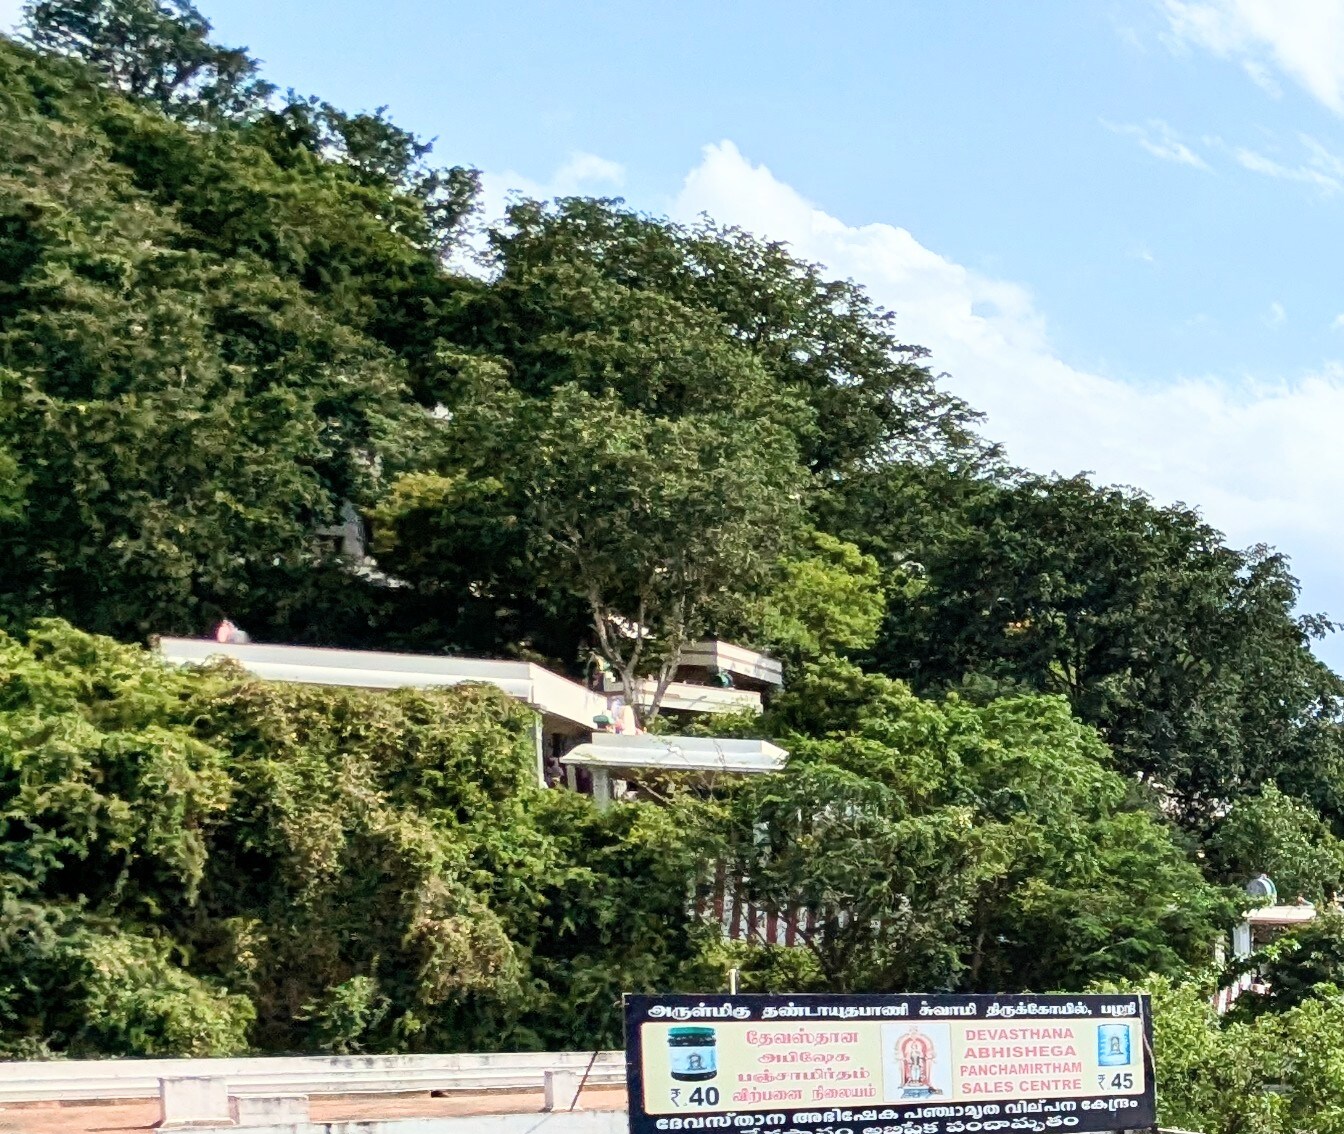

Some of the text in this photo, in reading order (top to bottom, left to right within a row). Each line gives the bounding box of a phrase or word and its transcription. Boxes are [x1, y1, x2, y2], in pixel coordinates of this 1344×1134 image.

[647, 1002, 751, 1020] அருள்மிகு
[761, 1001, 909, 1018] தண்டாயுதபாணி
[746, 1027, 860, 1047] தேவஸ்தான
[965, 1028, 1075, 1042] DEVASTHANA
[757, 1050, 851, 1064] அபிஷேக
[963, 1045, 1077, 1060] ABHISHEGA
[959, 1062, 1083, 1077] PANCHAMIRTHAM
[732, 1083, 877, 1105] விற்பனை நிலையம்
[962, 1078, 1082, 1095] SALES CENTRE
[792, 1108, 899, 1124] അഭിഷേക
